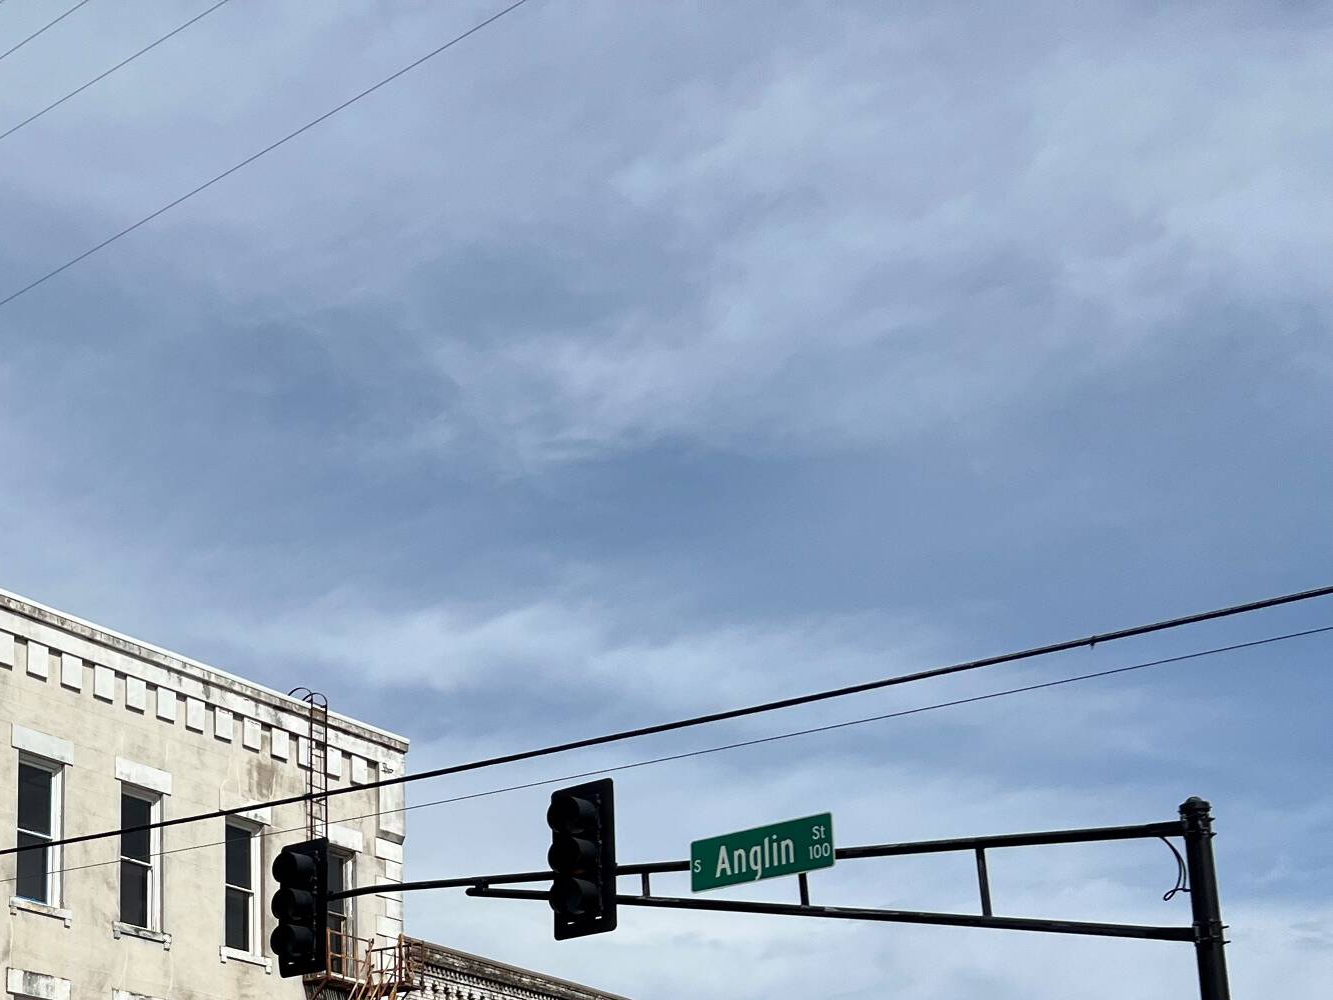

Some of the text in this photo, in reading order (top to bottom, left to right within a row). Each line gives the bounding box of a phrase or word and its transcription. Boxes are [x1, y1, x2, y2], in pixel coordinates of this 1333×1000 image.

[693, 825, 826, 881] S Anglin St
[808, 842, 831, 860] 100
